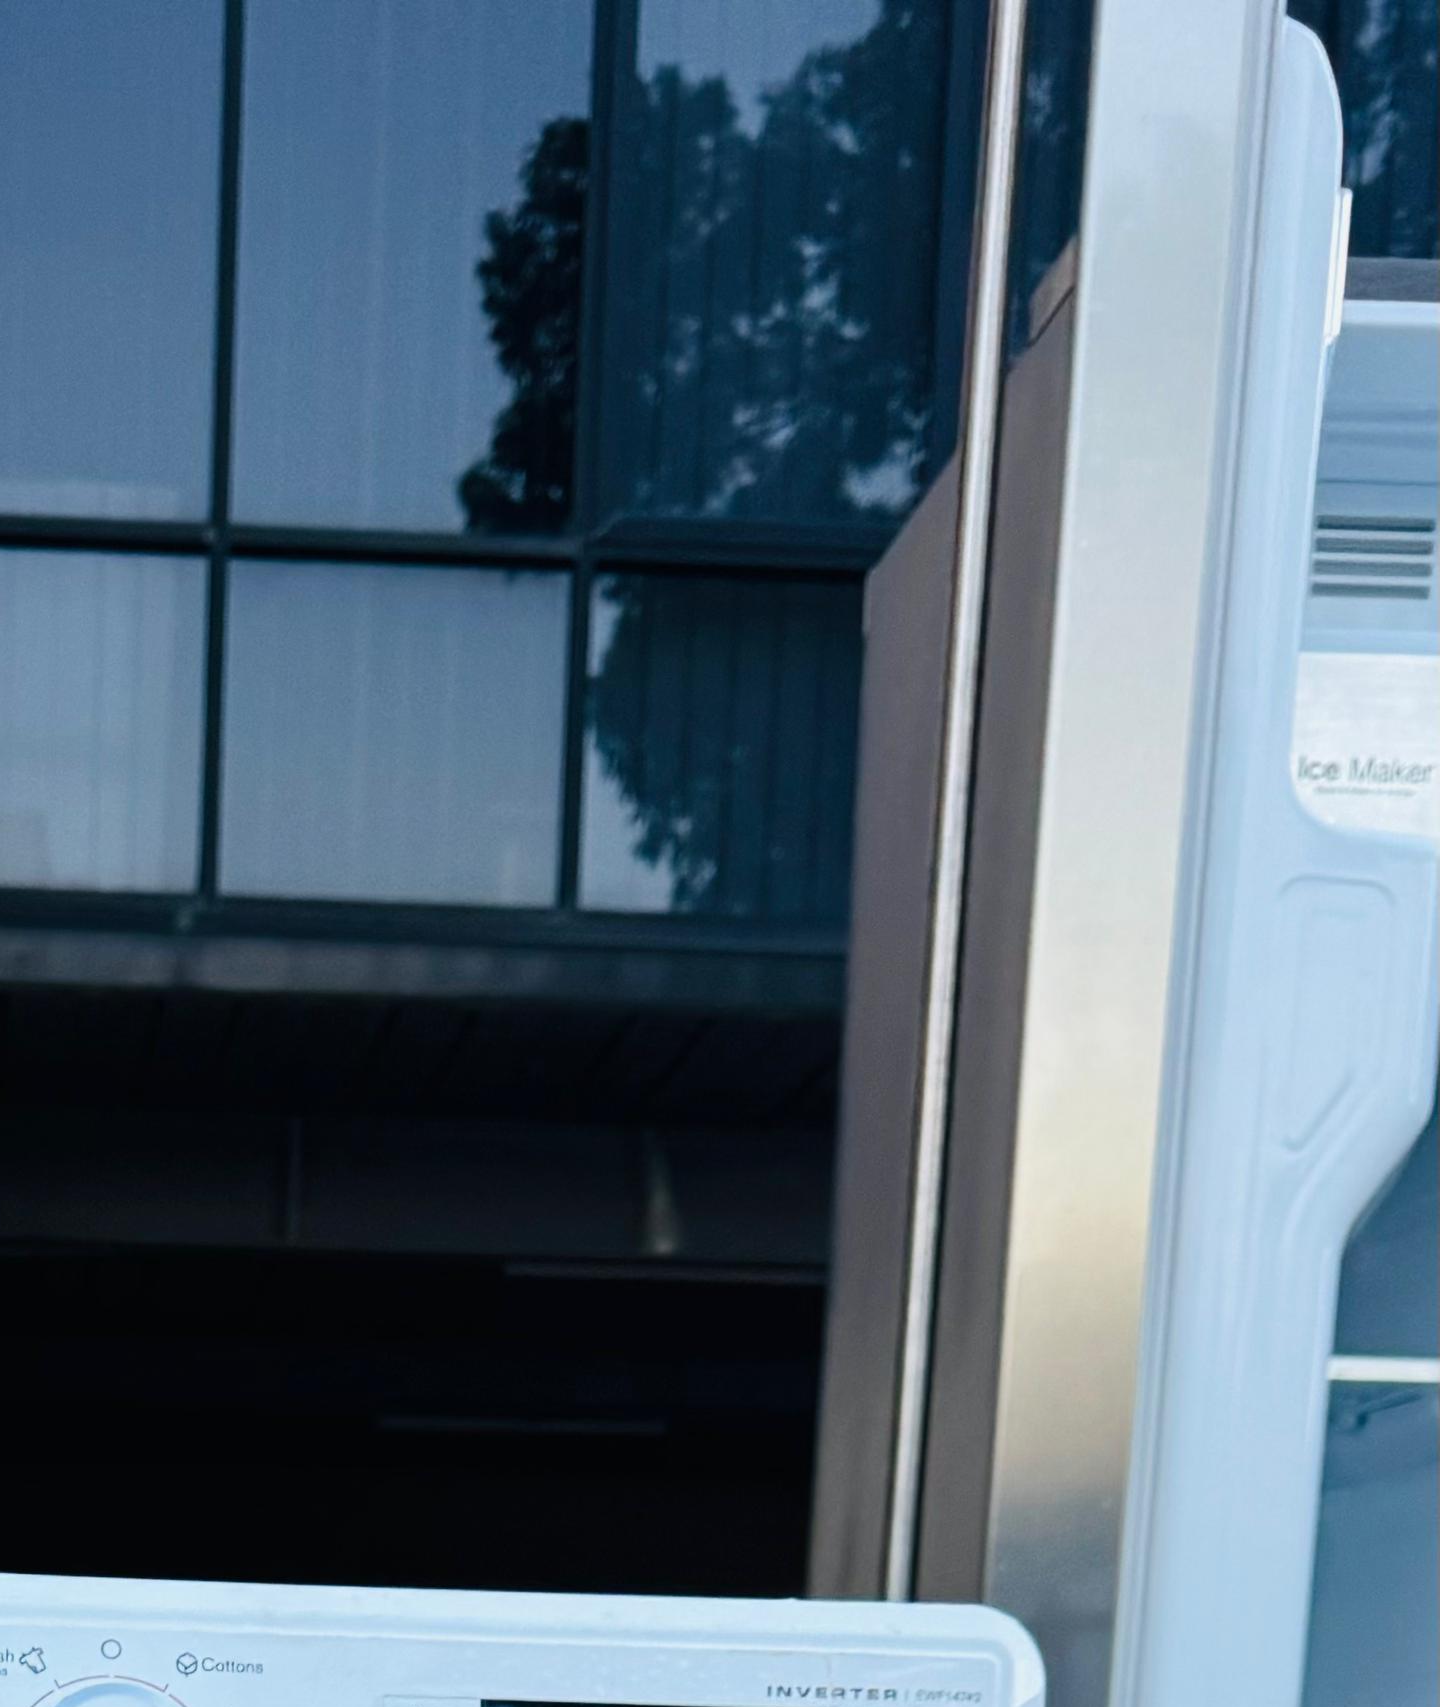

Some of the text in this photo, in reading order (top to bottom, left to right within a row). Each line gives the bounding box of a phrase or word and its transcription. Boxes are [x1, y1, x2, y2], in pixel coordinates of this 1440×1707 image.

[1347, 757, 1434, 784] Maker
[201, 1656, 264, 1674] Cottons
[766, 1685, 898, 1702] INVERTER
